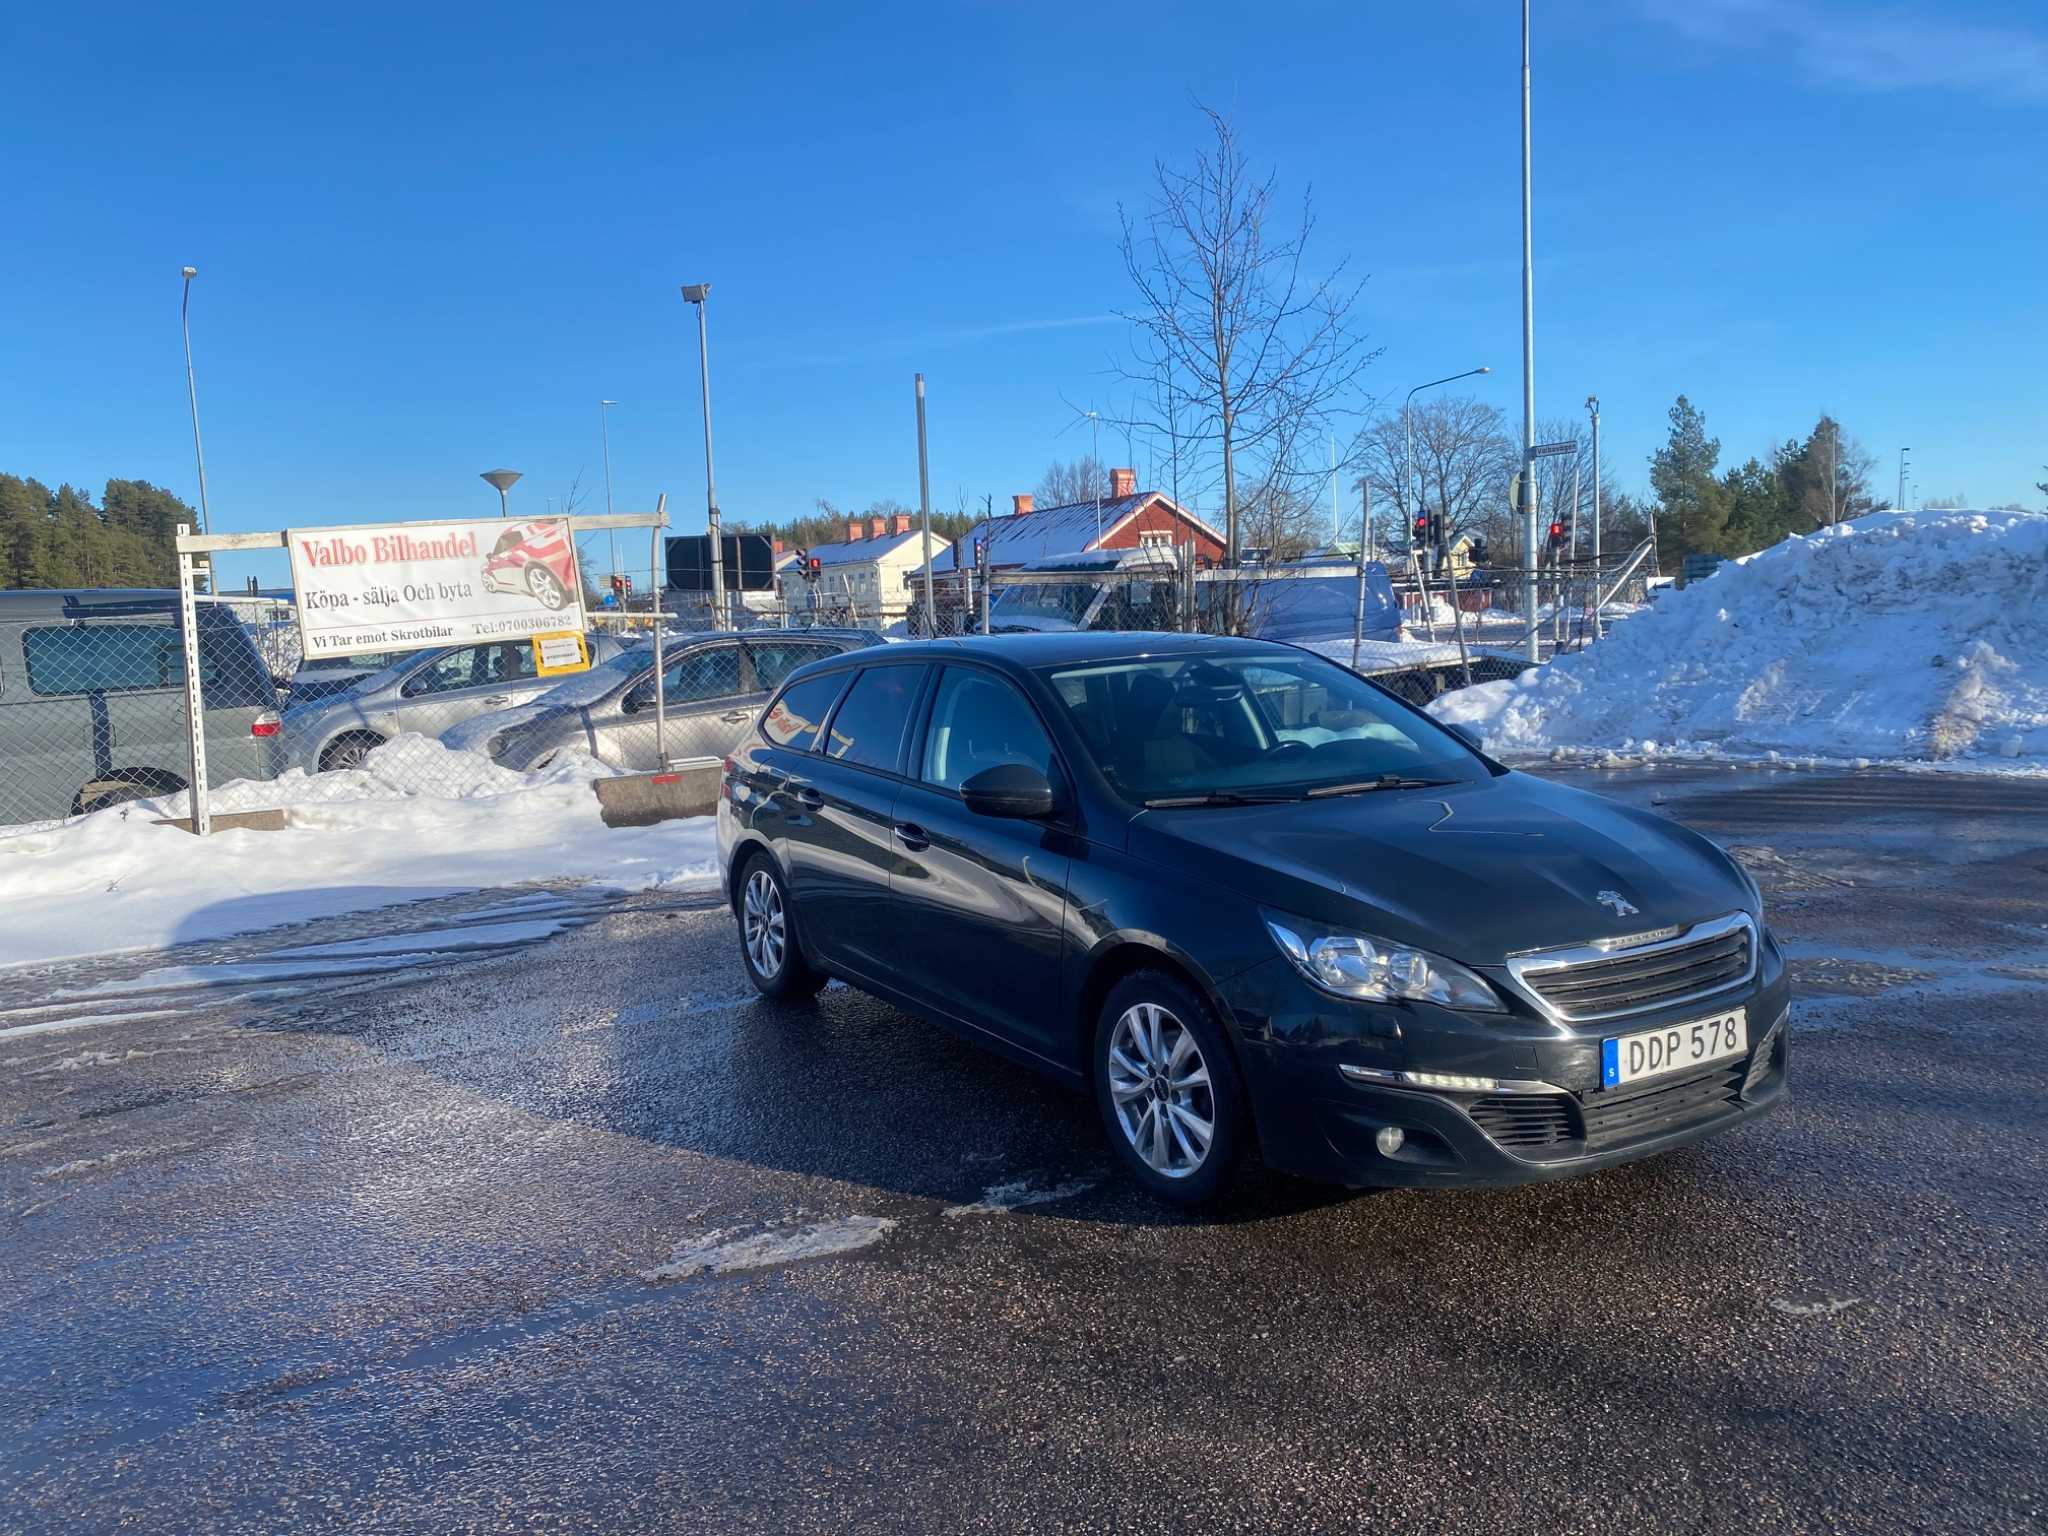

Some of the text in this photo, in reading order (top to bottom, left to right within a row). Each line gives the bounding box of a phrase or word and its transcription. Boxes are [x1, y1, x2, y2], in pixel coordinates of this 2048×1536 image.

[302, 530, 478, 567] Valbo Bilhandel
[304, 590, 350, 611] Köpa
[363, 585, 400, 607] sälja
[403, 583, 436, 602] Och
[437, 580, 473, 602] byta
[312, 624, 454, 648] Vi Tar emot Skrotbilar
[471, 615, 572, 635] Tel:0700306782
[1629, 1016, 1737, 1076] DDP 578
[1608, 1067, 1615, 1078] S
